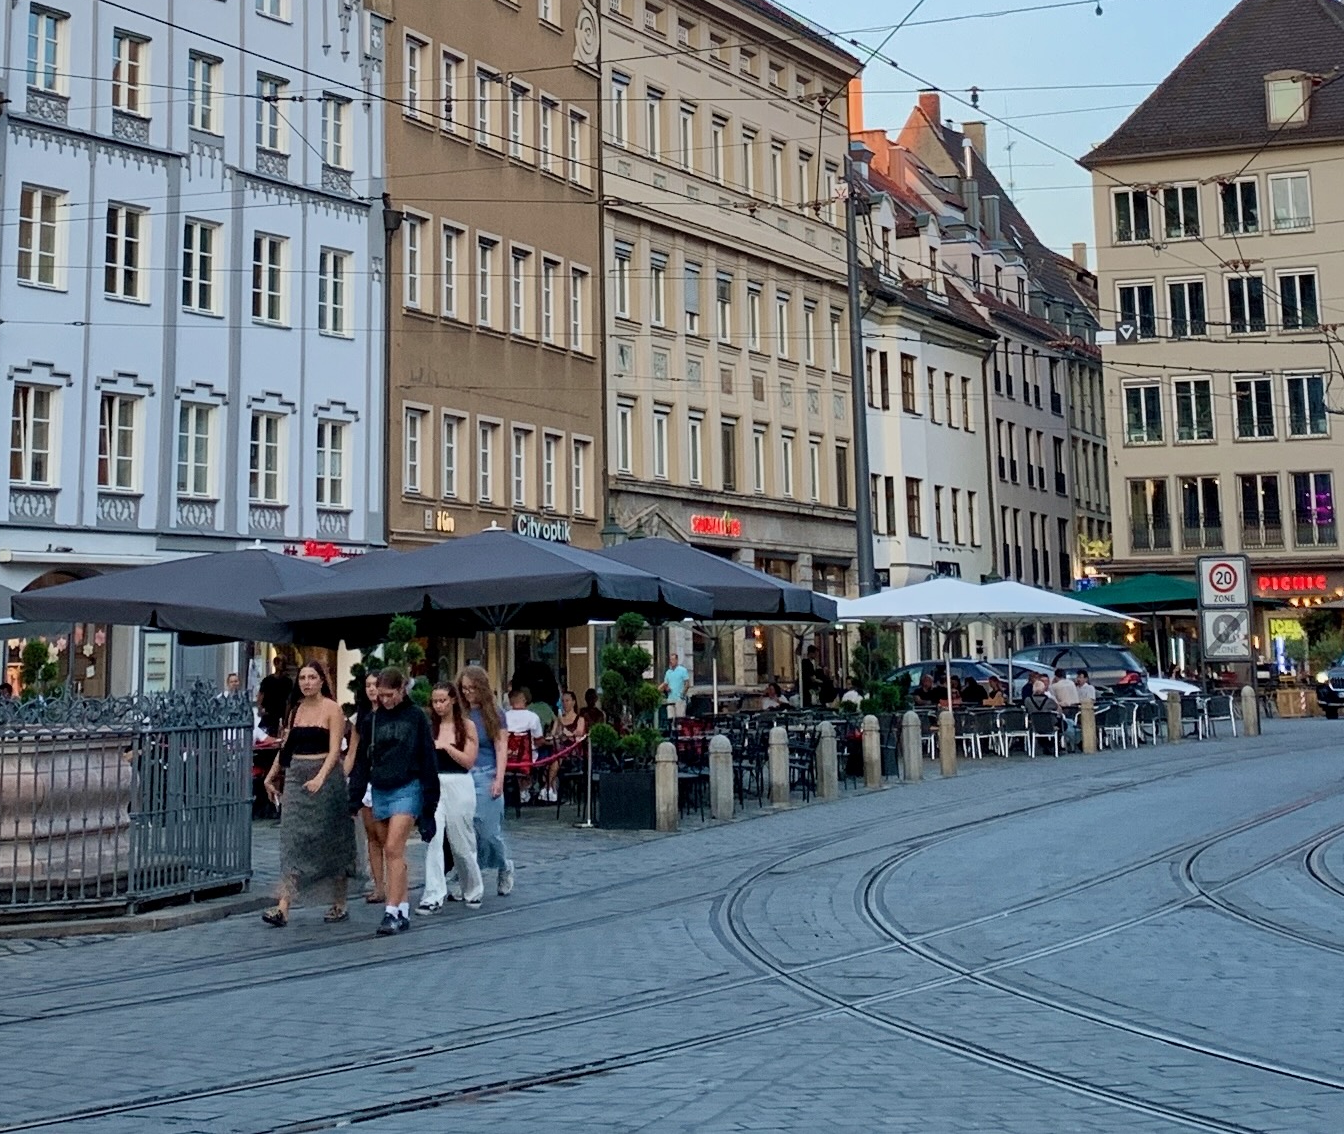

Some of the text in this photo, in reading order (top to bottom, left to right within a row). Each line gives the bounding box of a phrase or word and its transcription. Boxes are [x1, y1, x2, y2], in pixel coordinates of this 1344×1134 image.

[517, 515, 571, 542] City optik
[1215, 571, 1232, 585] 20
[1258, 575, 1327, 591] PICNIC
